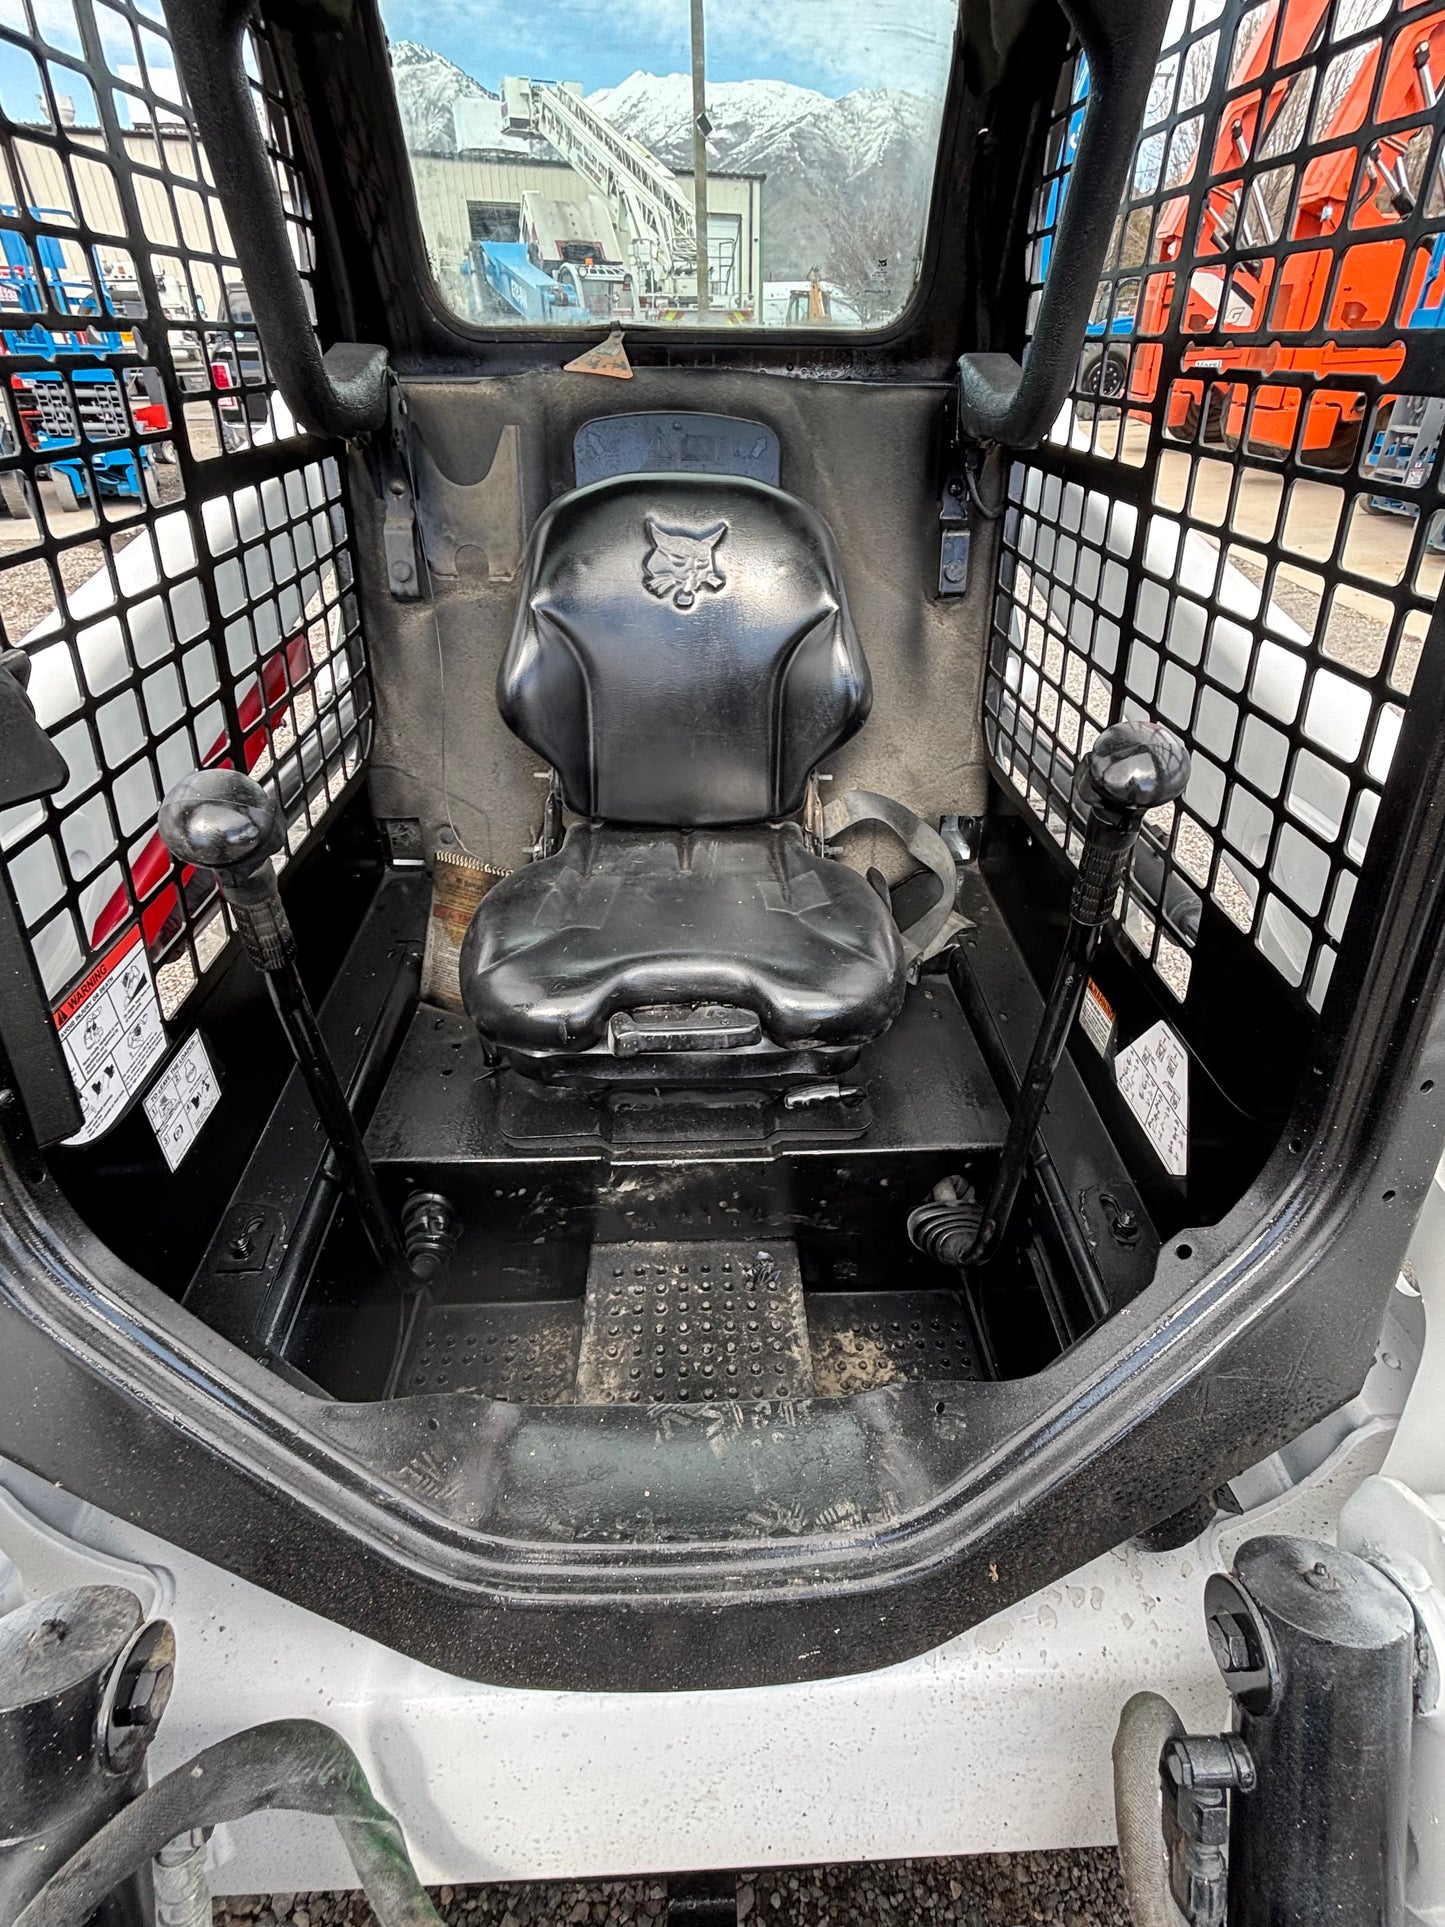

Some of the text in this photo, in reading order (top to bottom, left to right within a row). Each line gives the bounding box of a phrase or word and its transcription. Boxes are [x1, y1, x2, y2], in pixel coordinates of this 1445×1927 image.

[60, 976, 114, 1038] AVOID INJURY OR DEATH
[67, 963, 108, 1010] WARNING
[150, 1093, 159, 1102] TO
[158, 1074, 171, 1093] LEAVE
